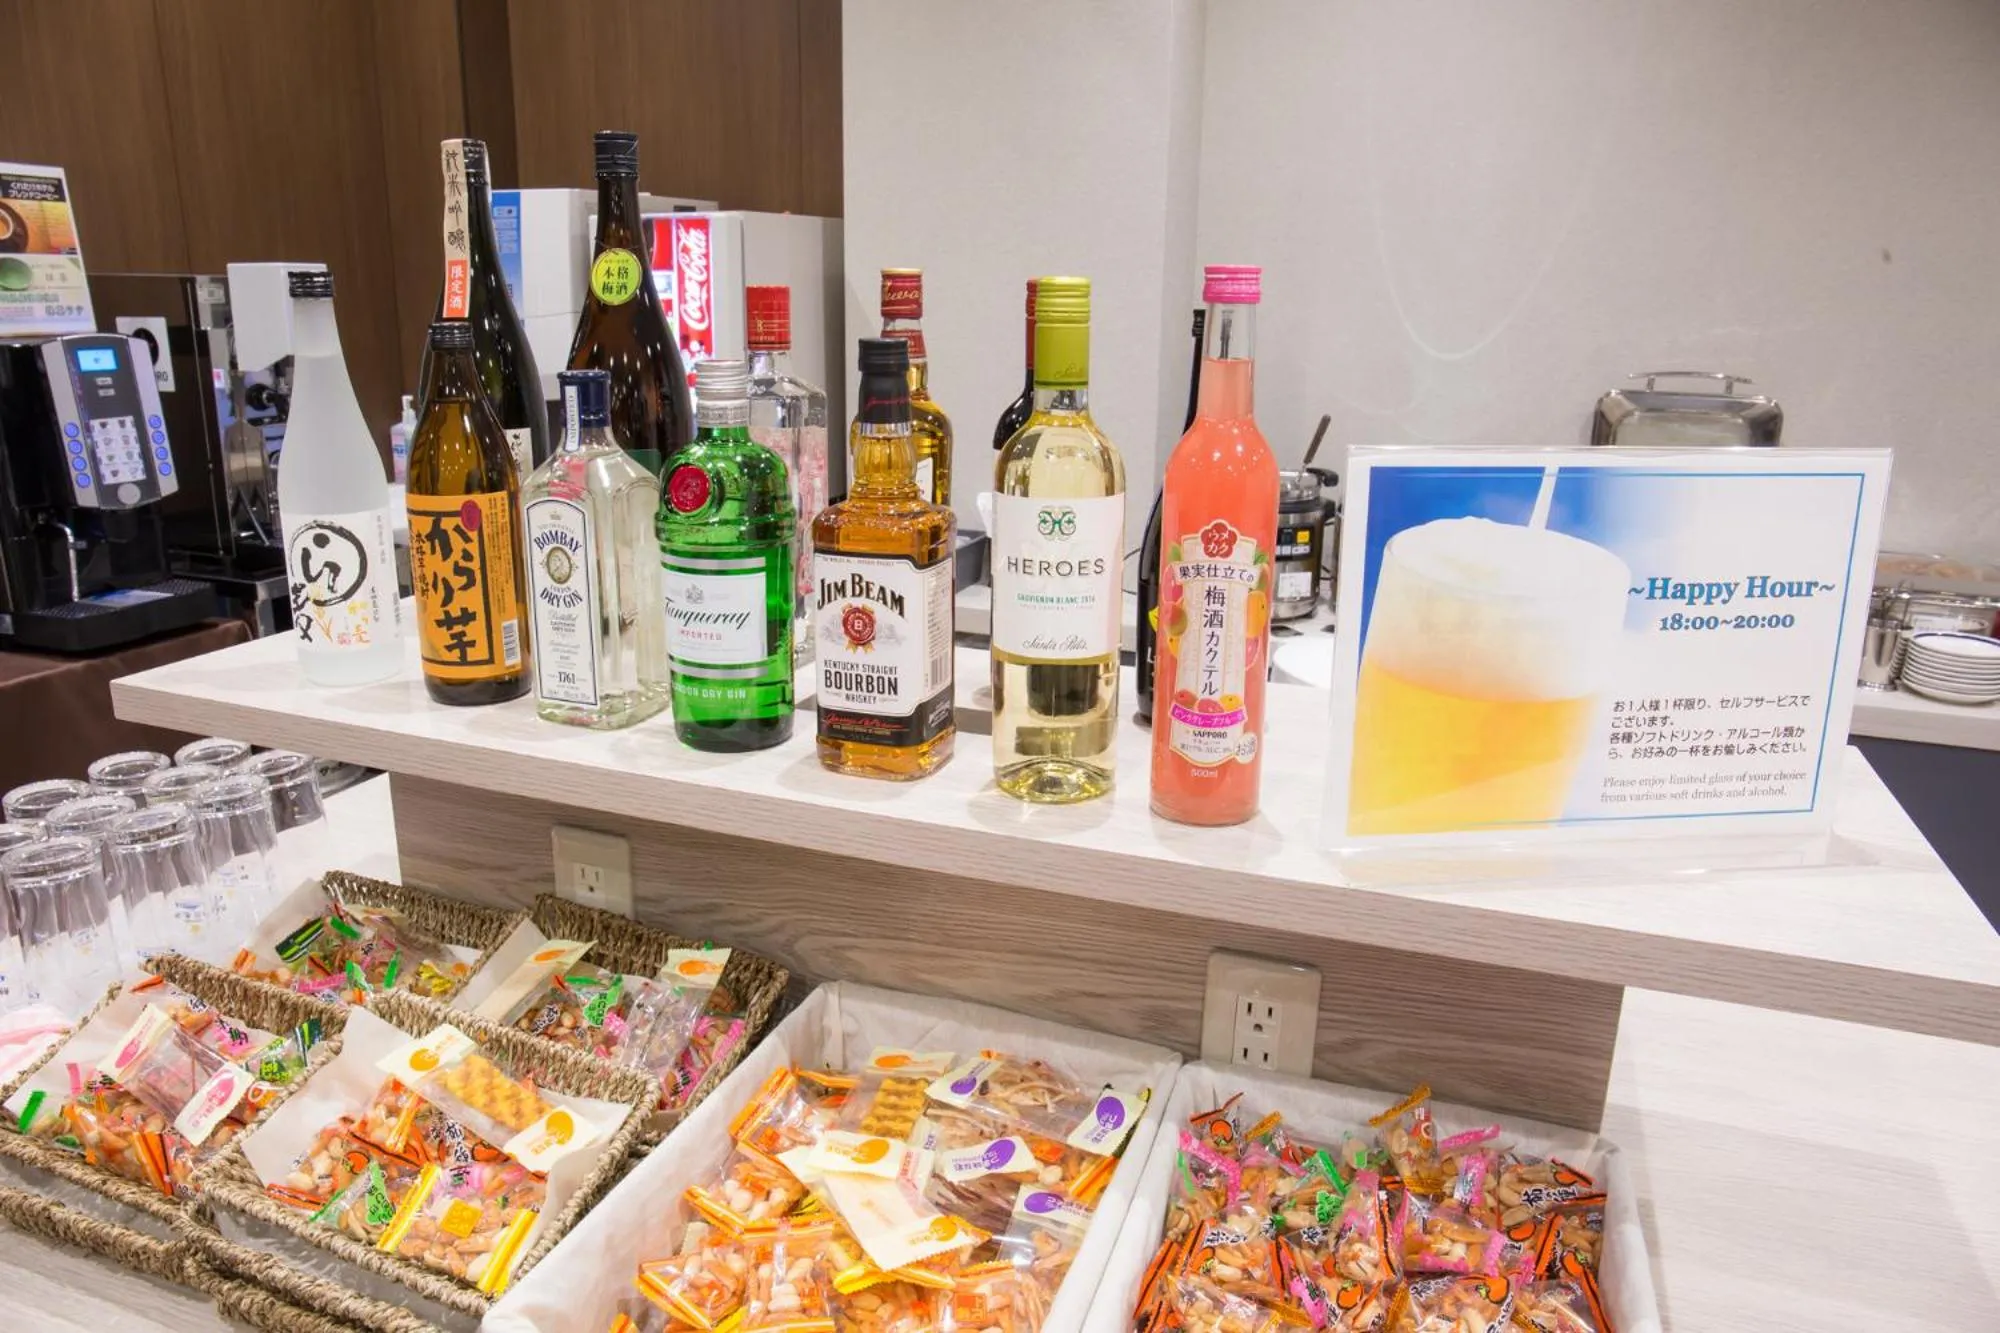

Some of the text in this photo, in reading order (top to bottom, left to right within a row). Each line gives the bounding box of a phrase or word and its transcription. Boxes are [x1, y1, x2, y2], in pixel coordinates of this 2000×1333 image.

[603, 266, 629, 280] 本格
[678, 222, 710, 331] Coca-Cola
[450, 265, 463, 309] 限定酒
[602, 281, 628, 296] 梅酒
[533, 530, 583, 553] BOMBAY
[1208, 528, 1230, 540] ウメ
[1207, 542, 1229, 555] カク
[1007, 556, 1105, 577] HEROES
[1179, 563, 1254, 583] 果実仕立ての
[540, 587, 583, 608] DRY GIN
[817, 578, 847, 610] JIM
[851, 572, 905, 619] BEAM
[1017, 592, 1055, 604] SAUVIGNON
[1056, 595, 1078, 604] BLANC
[665, 596, 751, 631] Tanqueray
[854, 619, 864, 630] B
[1659, 613, 1796, 632] 18:00~20:00
[1022, 634, 1057, 651] Santa
[1203, 584, 1227, 697] 梅酒カクテル
[823, 659, 898, 676] KENTUCKY STRAIGHT
[558, 671, 576, 684] 1761
[824, 669, 898, 697] BOURBON
[702, 688, 722, 699] DRY
[727, 688, 747, 699] GIN
[845, 693, 877, 705] WHISKEY
[1611, 715, 1675, 729] ございます。
[1192, 729, 1228, 740] SAPPORO
[1603, 777, 1636, 788] Please
[1639, 777, 1665, 789] enjoy
[1669, 774, 1706, 785] limited
[1708, 773, 1733, 787] glass
[1748, 772, 1772, 784] your
[1774, 771, 1806, 782] choice
[1600, 782, 1787, 804] from various soft drinks and alcohol.
